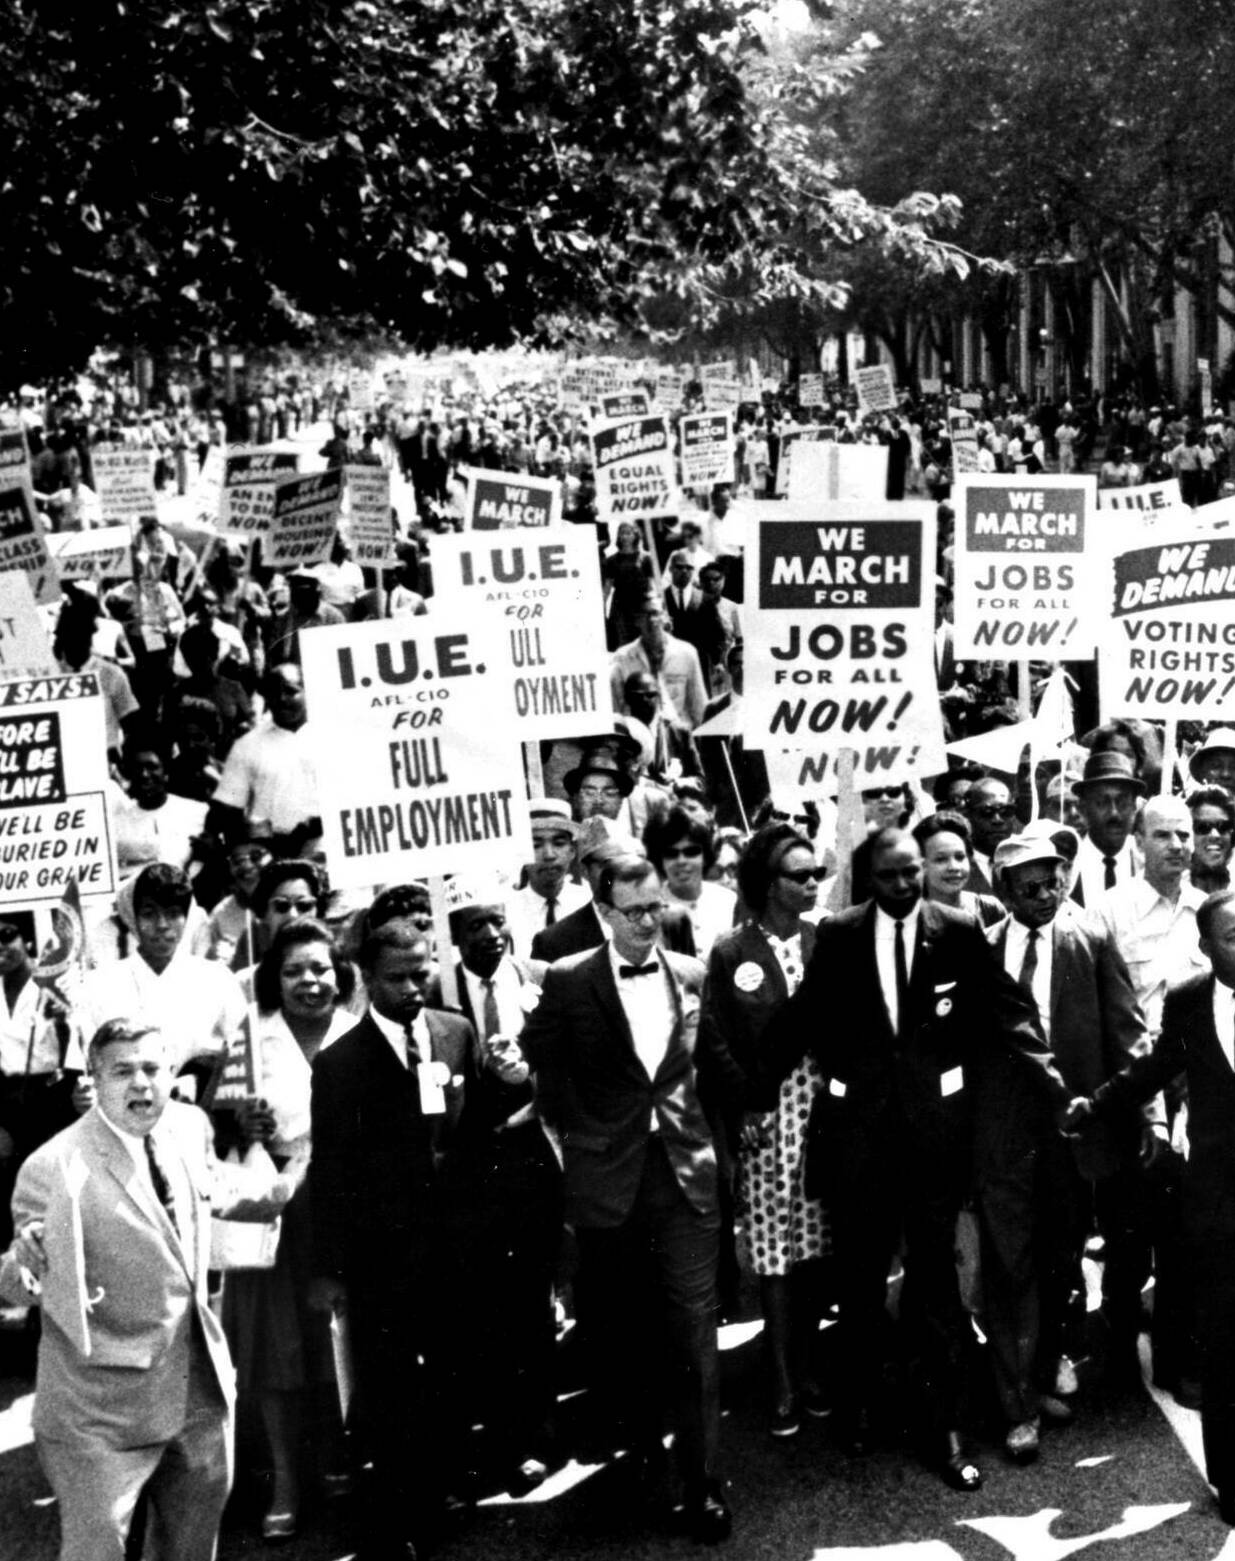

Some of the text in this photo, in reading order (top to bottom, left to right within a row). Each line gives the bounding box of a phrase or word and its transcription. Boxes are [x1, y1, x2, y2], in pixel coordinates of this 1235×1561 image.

[616, 422, 641, 442] WE
[687, 426, 726, 440] MARCH
[600, 431, 665, 463] DEMAND
[609, 465, 663, 480] EQUAL
[504, 486, 530, 502] WE
[610, 479, 668, 495] RIGHTS
[230, 501, 250, 514] TO
[478, 499, 547, 524] MARCH
[612, 493, 670, 513] NOW!
[1008, 492, 1045, 511] WE
[281, 512, 332, 528] DECENT
[974, 512, 1077, 535] MARCH
[272, 527, 333, 542] HOUSING
[817, 527, 866, 551] WE
[1006, 538, 1047, 550] FOR
[0, 538, 42, 561] LASS
[274, 540, 329, 558] NOW!
[1157, 543, 1210, 575] WE
[459, 544, 580, 586] I.U.E.
[771, 555, 910, 585] MARCH
[974, 565, 1074, 591] JOBS
[814, 590, 868, 604] FOR
[977, 598, 1070, 609] FOR ALL
[505, 604, 545, 620] FOR
[770, 623, 908, 661] JOBS
[973, 617, 1078, 646] NOW!
[509, 627, 546, 668] ULL
[336, 634, 487, 690] I.U.E.
[1129, 648, 1235, 674] RIGHTS
[775, 668, 903, 684] FOR ALL
[14, 676, 94, 703] SAYS:
[513, 673, 597, 717] OYMENT
[1125, 676, 1235, 705] NOW!
[392, 707, 444, 730] FOR
[769, 691, 913, 734] NOW!
[0, 719, 51, 747] ORE
[26, 746, 57, 772] BE
[388, 736, 448, 789] FULL
[0, 773, 60, 801] LAVE,
[54, 808, 86, 831] BE
[340, 789, 512, 857] EMPLOYMENT
[0, 836, 99, 863] URIED IN
[36, 862, 103, 888] GRAVE
